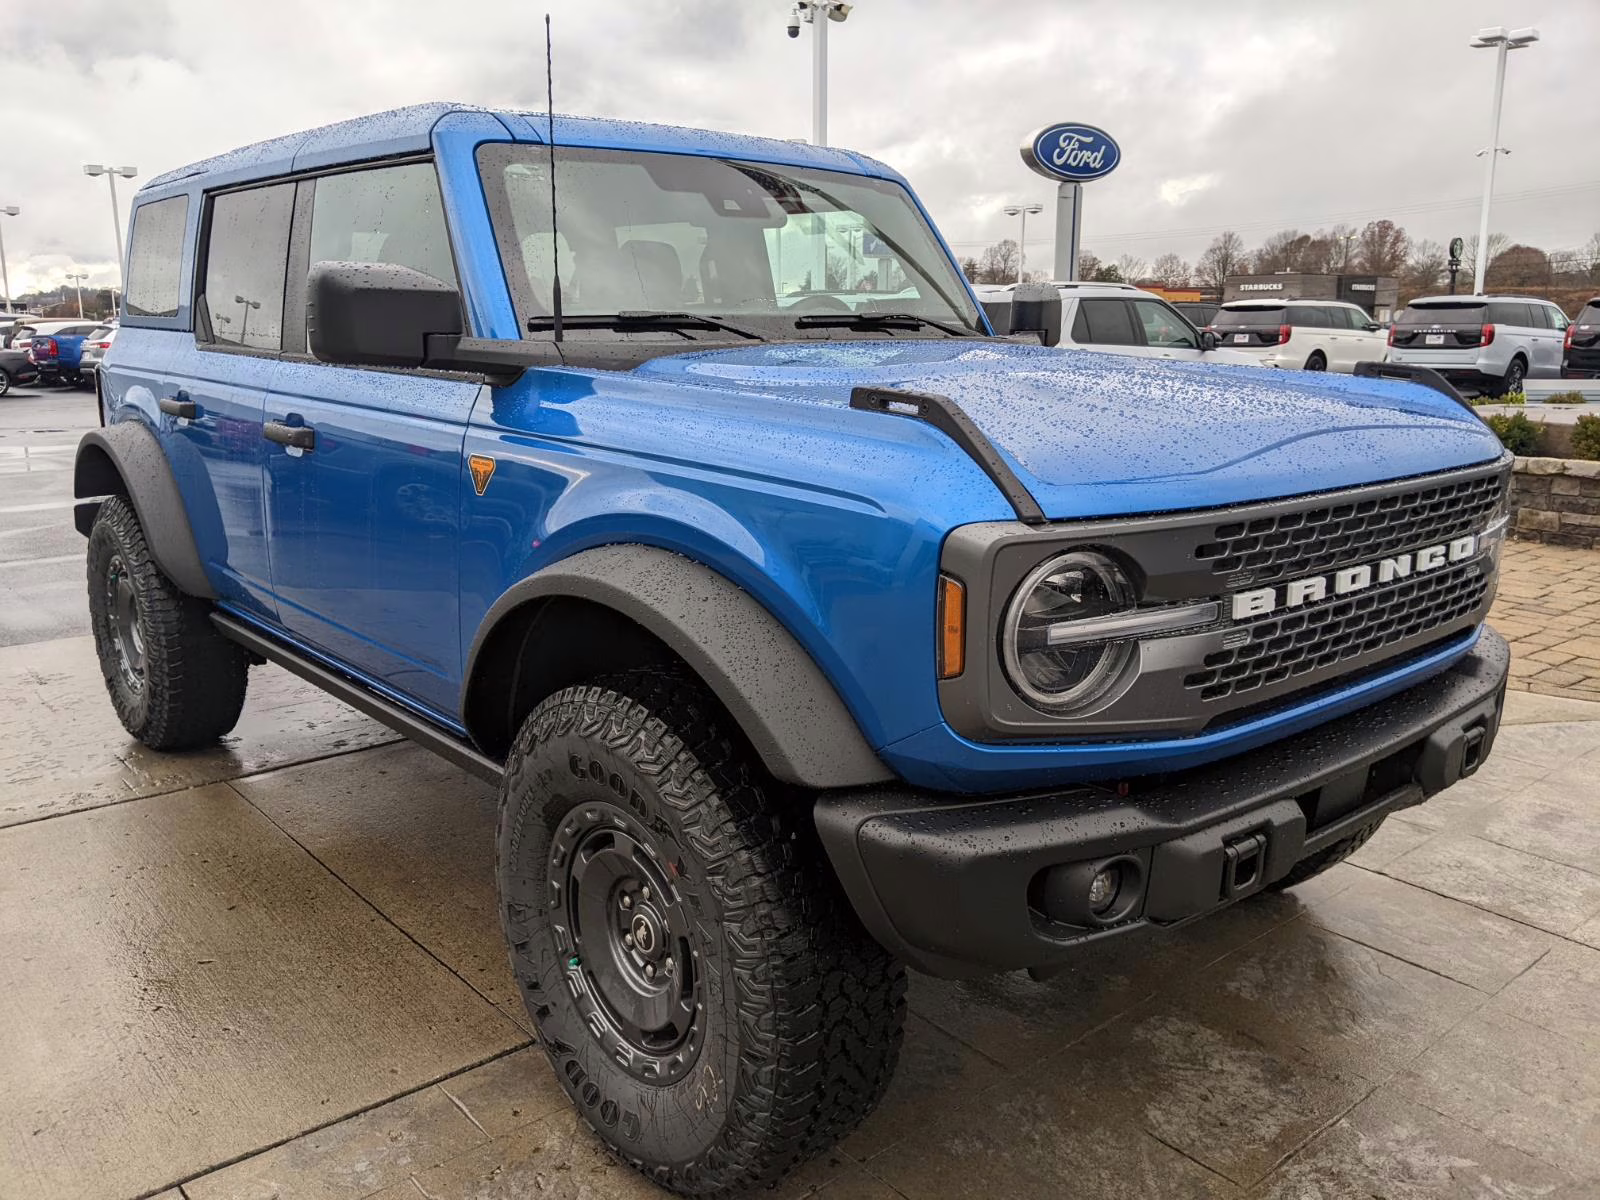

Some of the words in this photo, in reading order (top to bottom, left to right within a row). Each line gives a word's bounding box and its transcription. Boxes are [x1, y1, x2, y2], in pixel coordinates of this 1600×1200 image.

[1053, 132, 1106, 168] Ford
[1239, 283, 1283, 291] STARBUCKS
[1232, 535, 1475, 620] BRONCO
